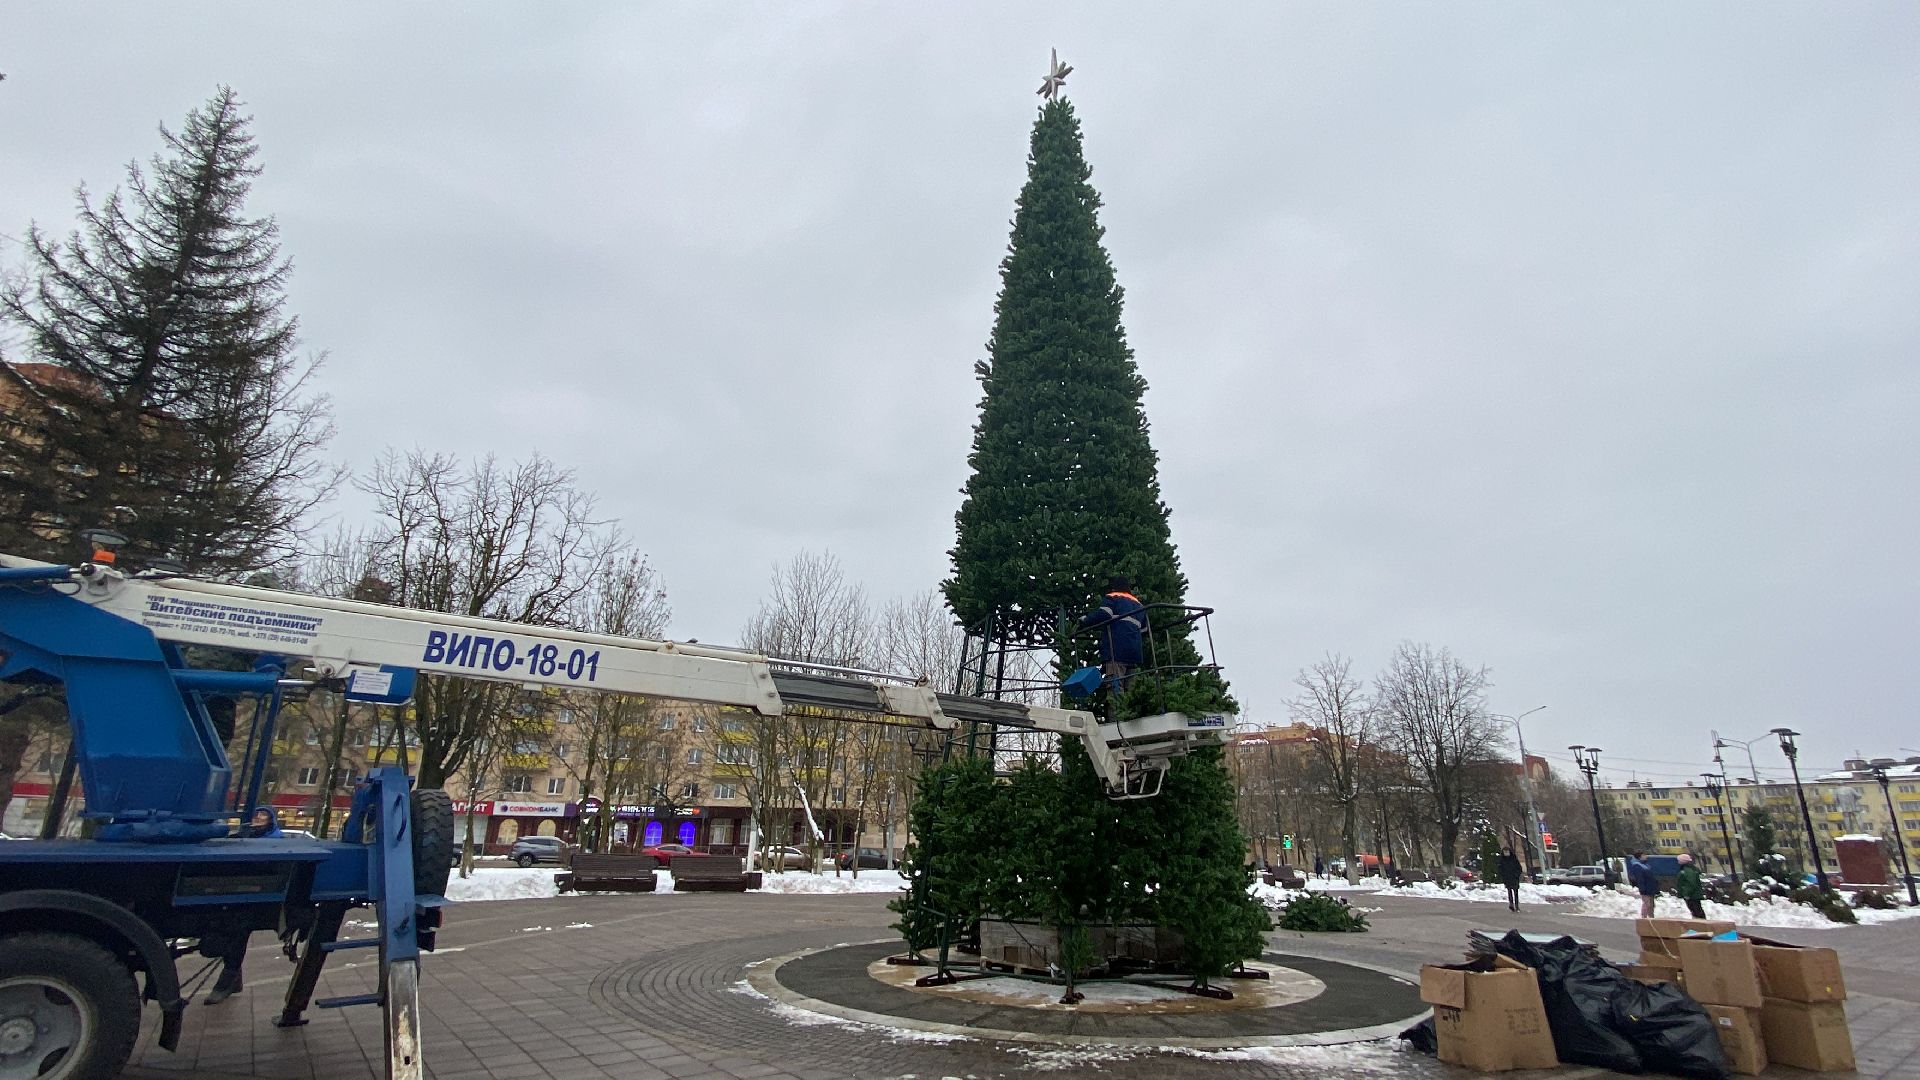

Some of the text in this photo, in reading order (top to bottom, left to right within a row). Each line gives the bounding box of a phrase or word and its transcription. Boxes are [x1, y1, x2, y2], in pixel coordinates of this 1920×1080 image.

[146, 601, 226, 619] "Витебские
[228, 614, 322, 631] подъемники"
[423, 630, 600, 681] ВИПО-18-01
[451, 802, 487, 812] АГНИТ
